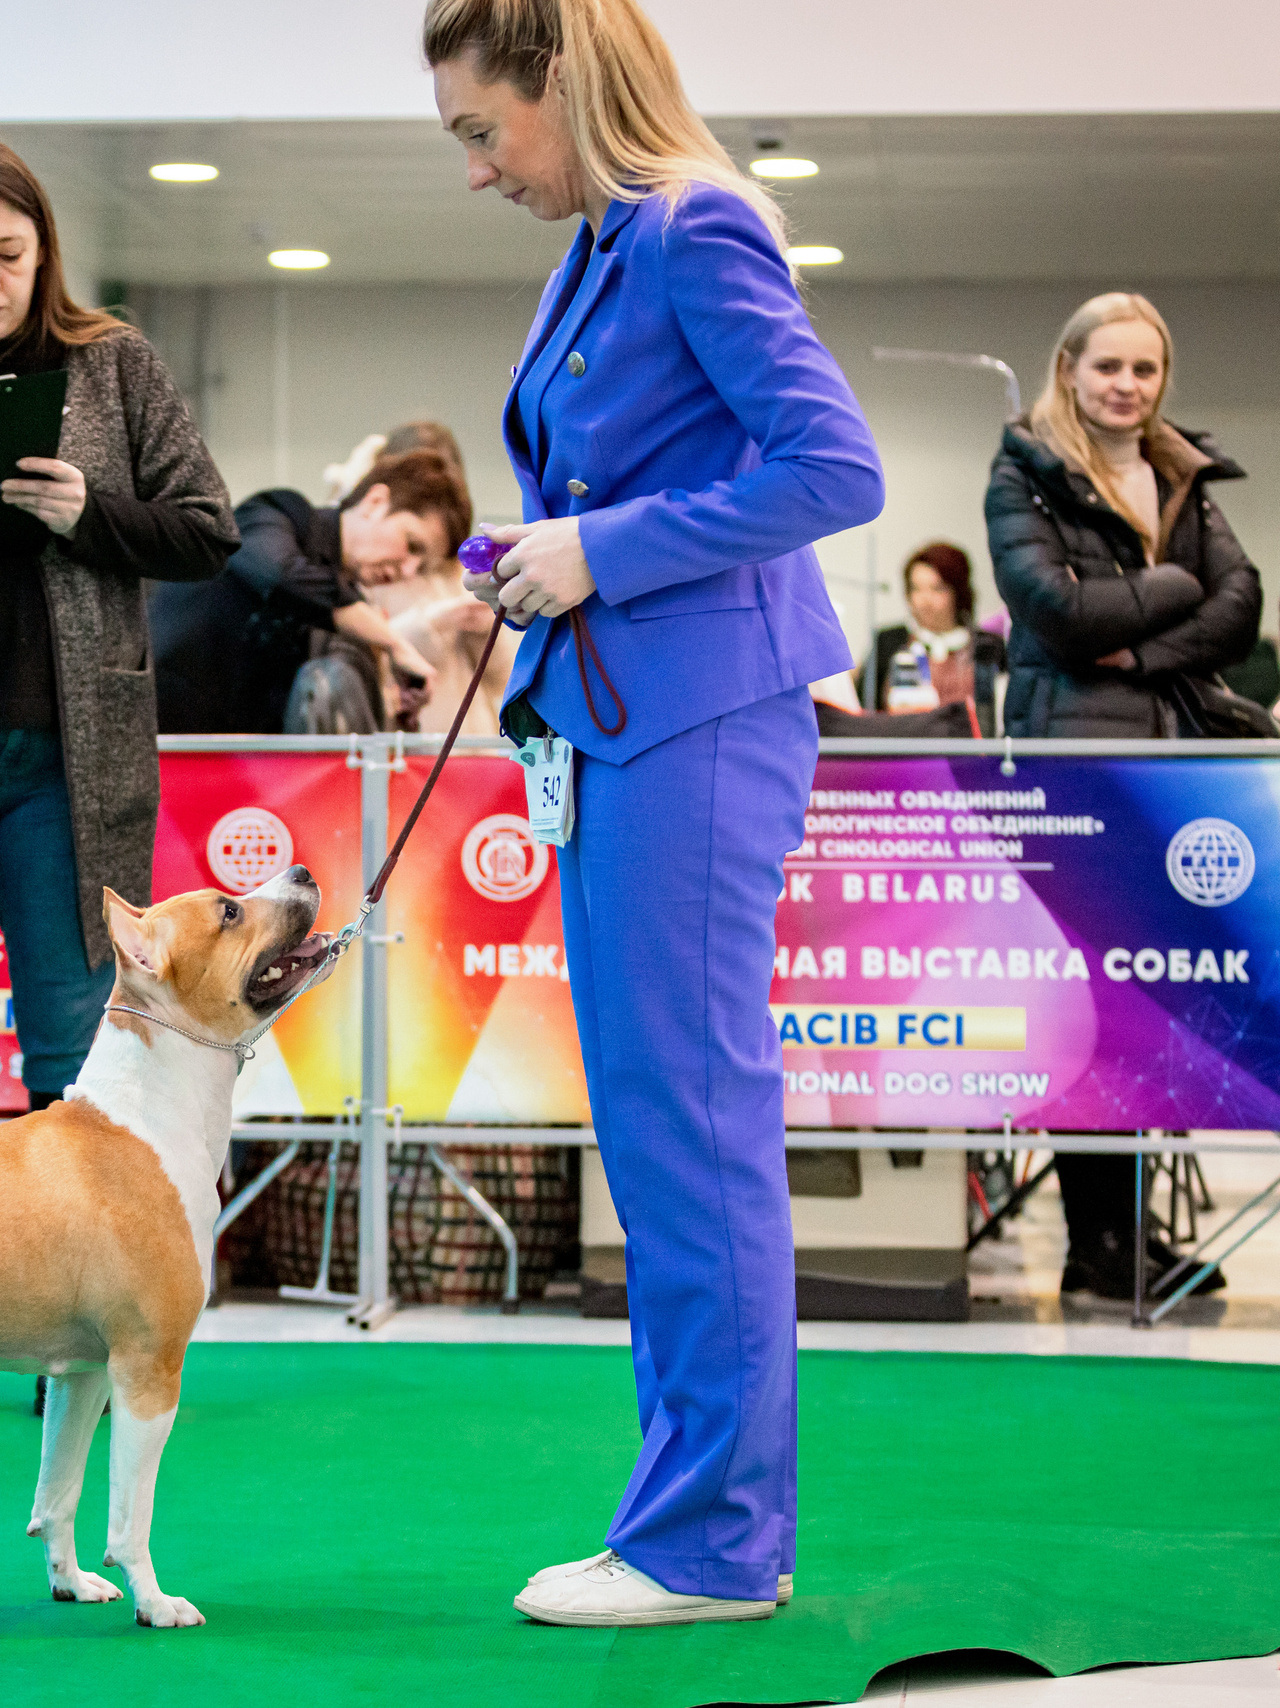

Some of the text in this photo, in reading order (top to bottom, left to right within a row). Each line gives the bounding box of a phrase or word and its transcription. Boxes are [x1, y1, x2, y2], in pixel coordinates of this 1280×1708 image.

[542, 775, 561, 808] 542
[900, 786, 1046, 812] ОБЪЕДИНЕНИЙ
[821, 838, 955, 859] CINOLOGICAL
[959, 839, 1023, 859] UNION
[842, 873, 1021, 903] BELARUS
[861, 946, 1090, 981] ВЫСТАВКА
[1103, 947, 1250, 983] СОБАК
[897, 1013, 964, 1046] FCI
[884, 1071, 950, 1096] DOG
[962, 1072, 1049, 1098] SHOW
